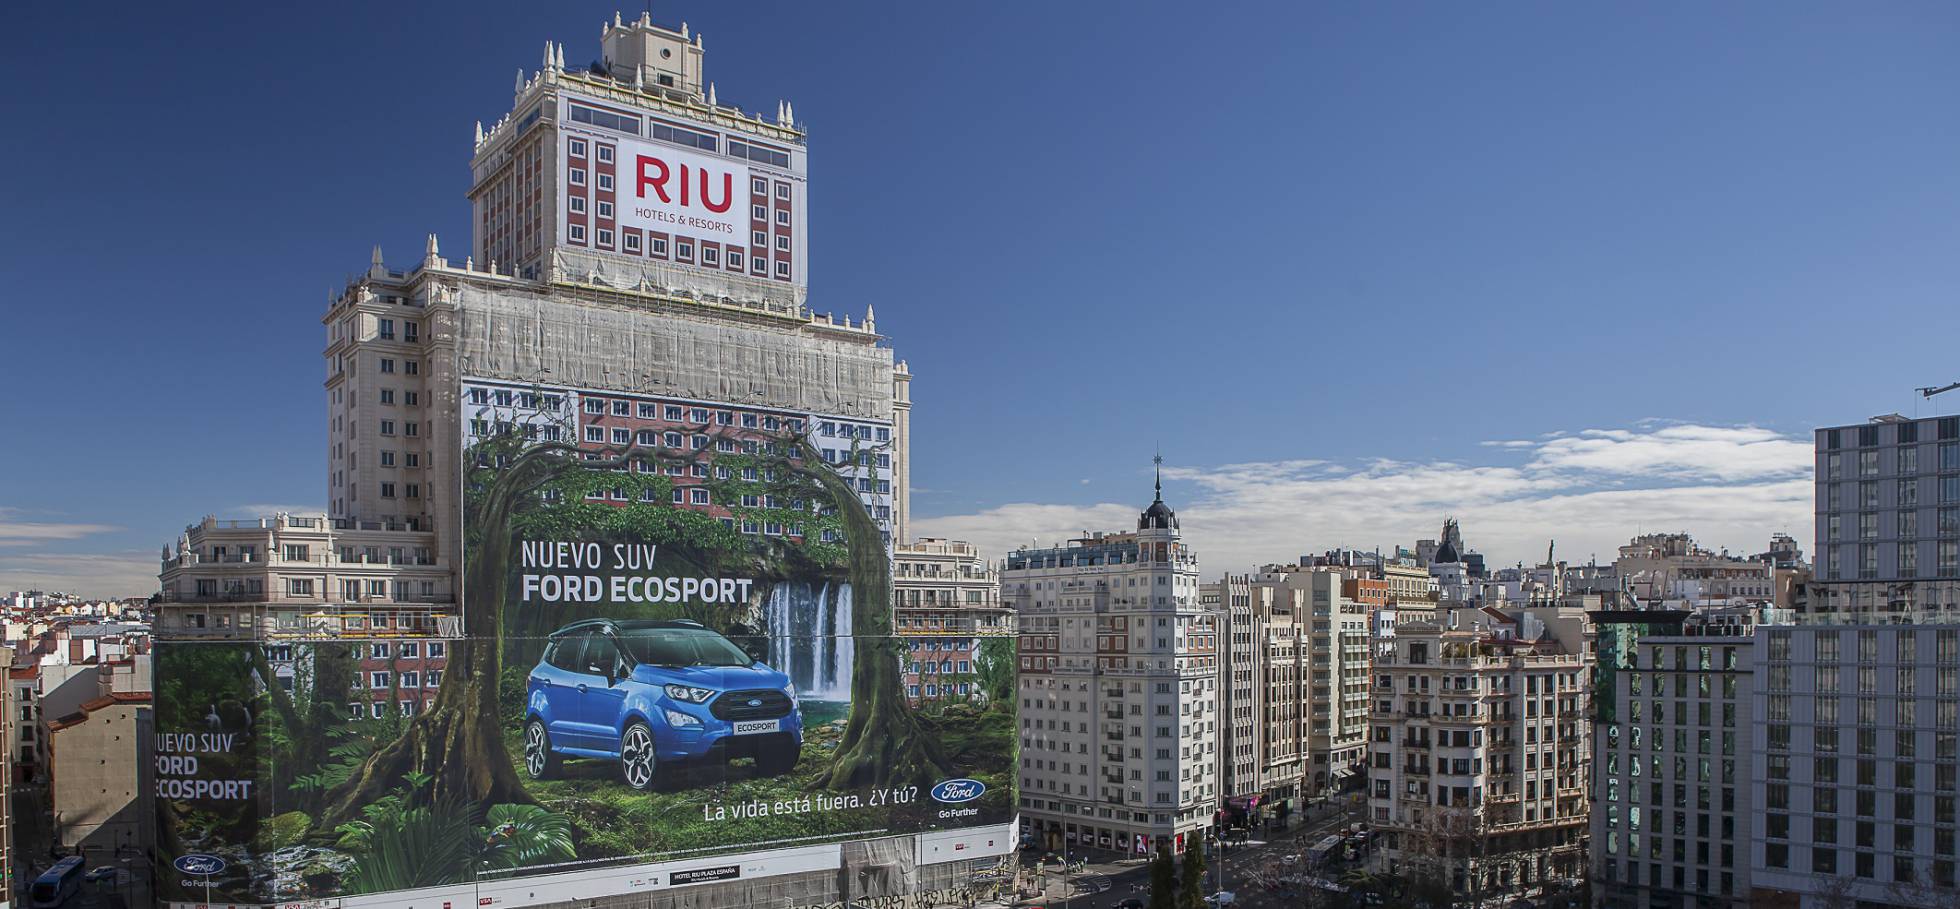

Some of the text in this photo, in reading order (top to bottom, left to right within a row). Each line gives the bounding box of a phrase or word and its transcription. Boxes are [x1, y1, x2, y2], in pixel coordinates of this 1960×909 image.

[636, 154, 733, 214] RIU
[635, 207, 733, 234] HOTELS & RESORTS
[522, 541, 657, 570] NUEVO SUV
[522, 574, 753, 603] FORD ECOSPORT
[737, 722, 777, 732] ECOSPORT
[200, 733, 233, 753] SUV
[941, 782, 976, 799] Ford
[704, 785, 918, 822] La vida está fuera. ¿Y tú?
[938, 807, 978, 819] Go Further
[181, 879, 192, 888] Go
[674, 872, 691, 880] HOTEL
[701, 868, 717, 877] PLAZA
